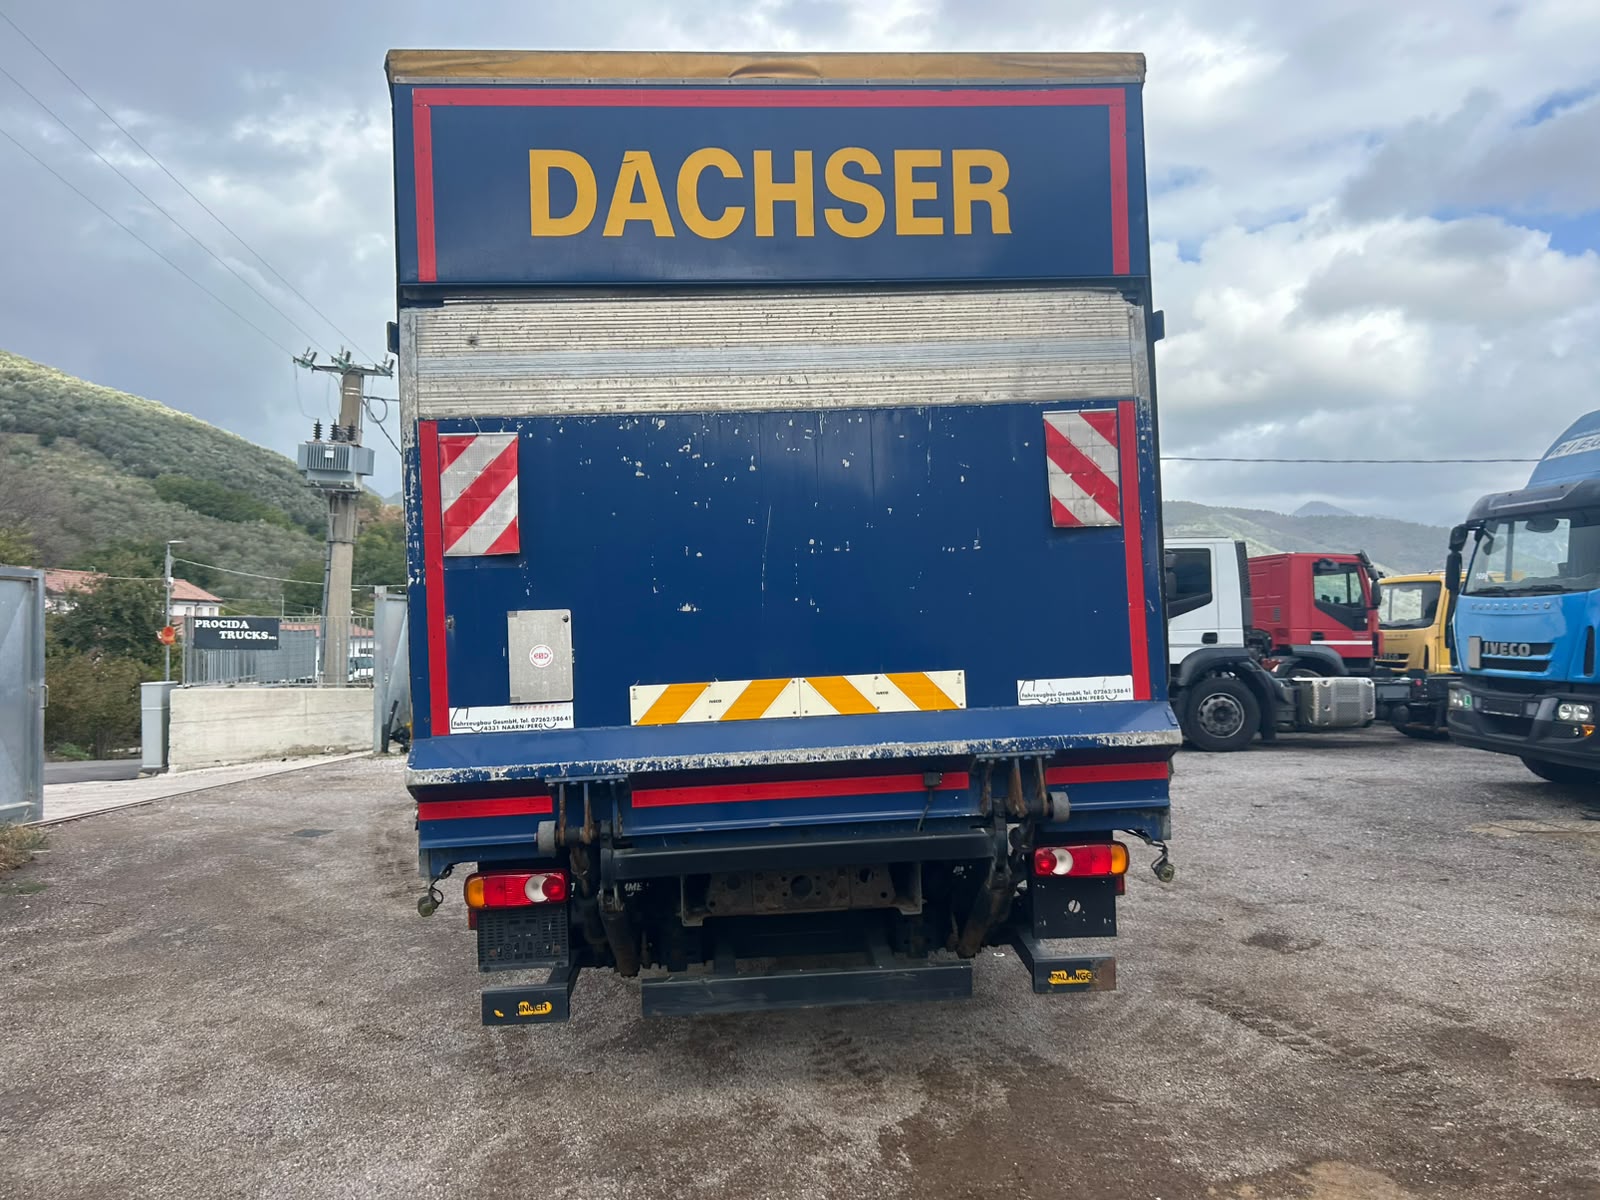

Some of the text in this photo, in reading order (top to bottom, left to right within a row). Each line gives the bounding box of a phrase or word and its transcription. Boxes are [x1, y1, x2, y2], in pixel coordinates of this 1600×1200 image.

[528, 147, 1012, 238] DACHSER
[194, 619, 250, 629] PROCIDA
[218, 630, 269, 640] TRUCKS
[1484, 641, 1531, 657] IVECO
